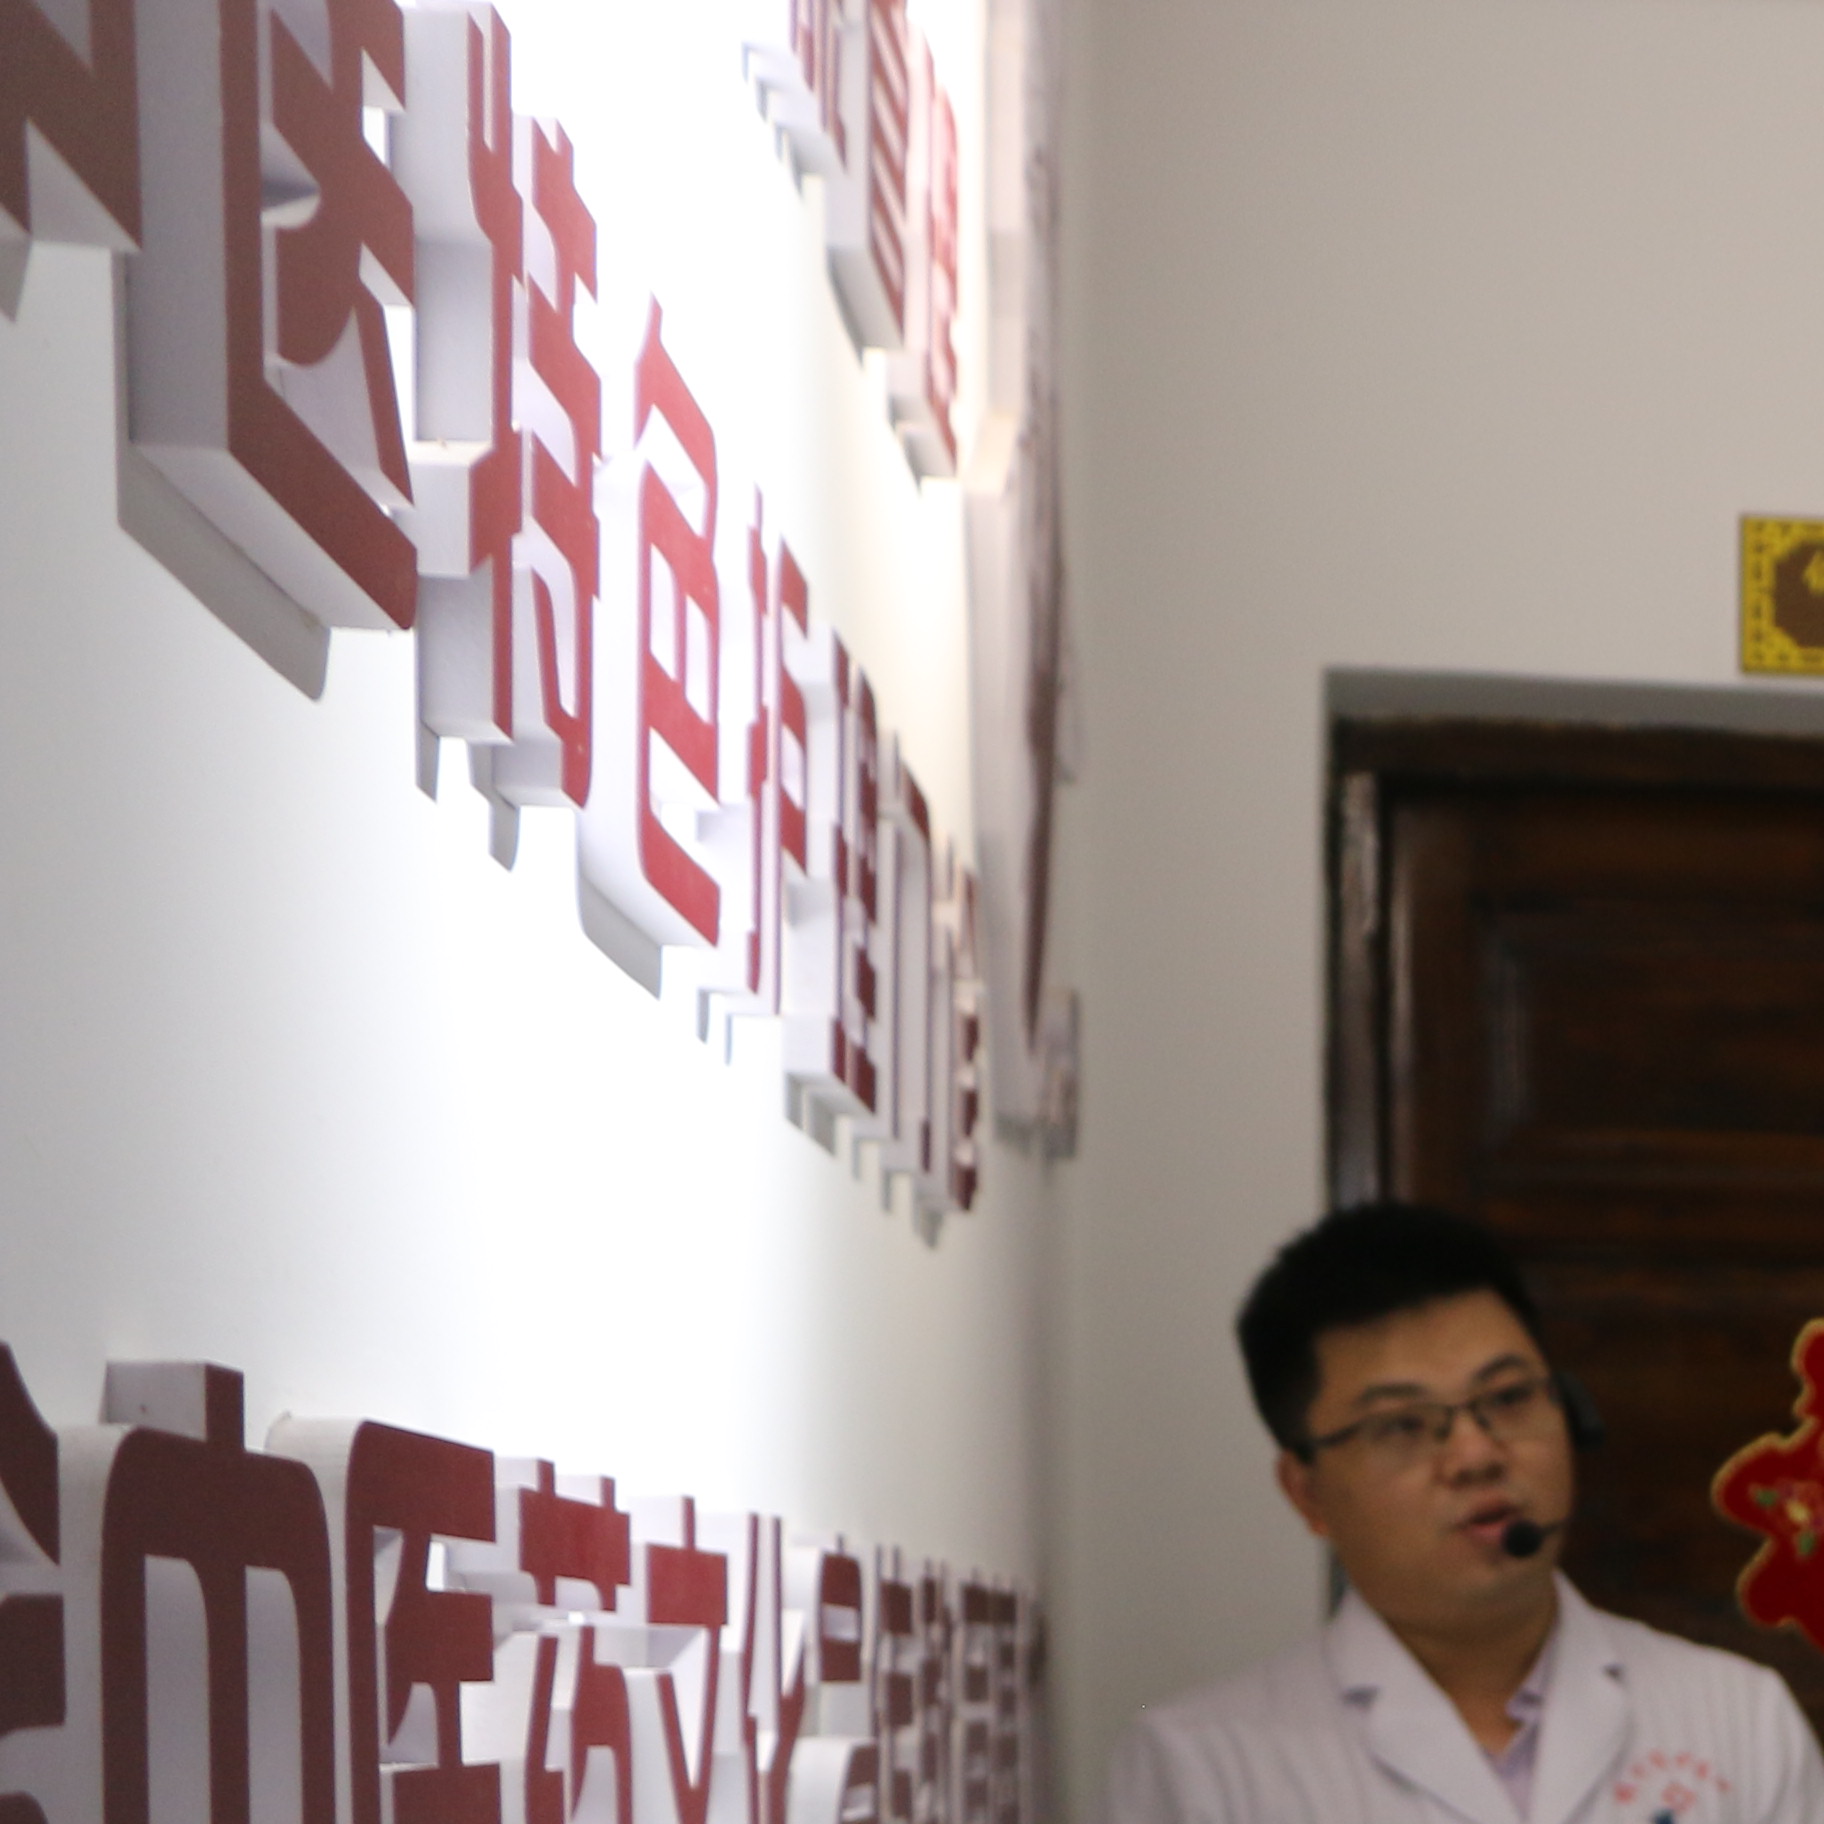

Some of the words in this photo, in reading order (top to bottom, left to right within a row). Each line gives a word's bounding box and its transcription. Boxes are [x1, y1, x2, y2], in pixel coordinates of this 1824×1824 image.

[0, 0, 981, 1213] 医特色护理门诊
